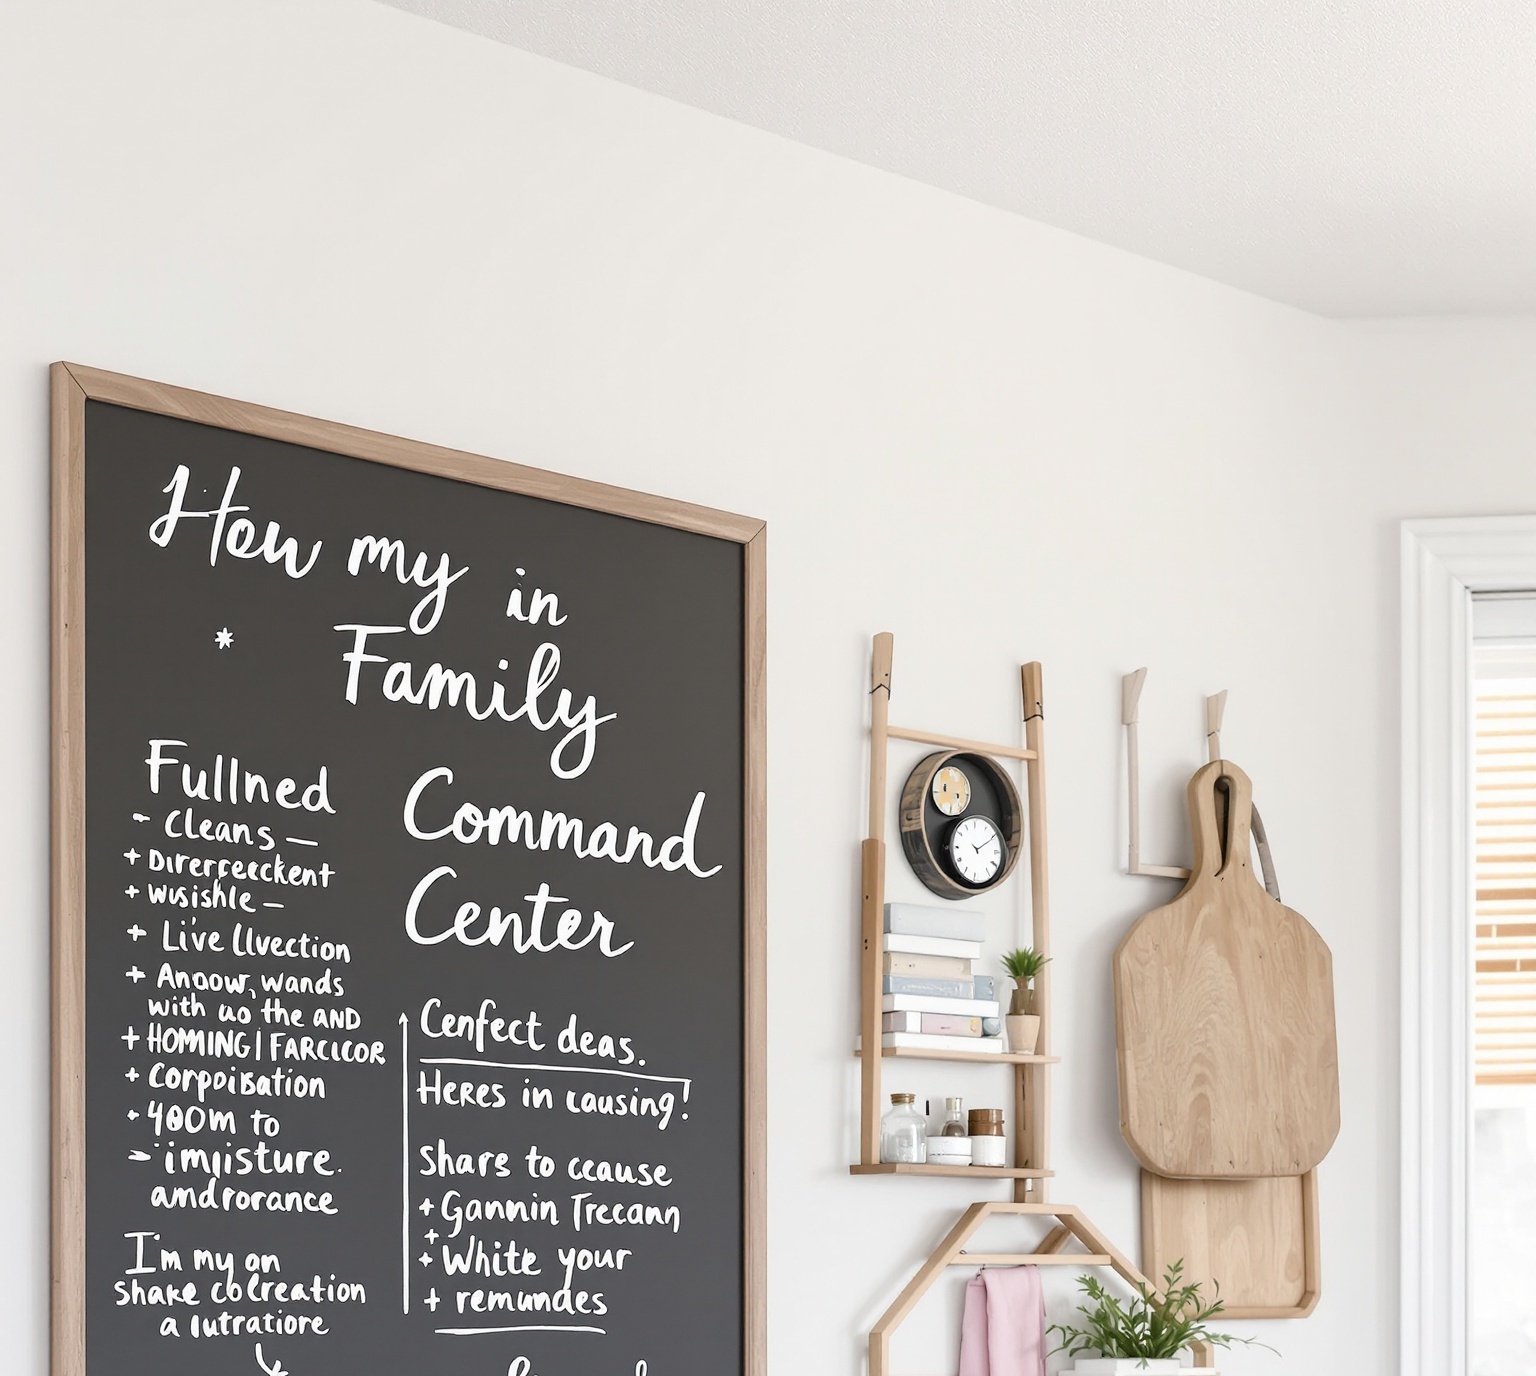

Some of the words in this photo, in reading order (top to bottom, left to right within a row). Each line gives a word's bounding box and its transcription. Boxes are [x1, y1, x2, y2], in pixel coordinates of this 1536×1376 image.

[148, 464, 323, 579] How
[346, 535, 470, 636] my
[506, 567, 568, 627] in
[333, 623, 618, 781] Family
[144, 739, 337, 815] Fullned
[403, 765, 723, 879] Command
[405, 865, 635, 958] Center
[260, 967, 345, 997] wands
[147, 991, 206, 1017] with
[260, 997, 305, 1028] the
[522, 1077, 553, 1110] in
[249, 1109, 280, 1138] to
[524, 1145, 556, 1179] to
[191, 1248, 237, 1293] my
[442, 1234, 542, 1278] White
[557, 1247, 633, 1291] your
[159, 1316, 181, 1338] a
